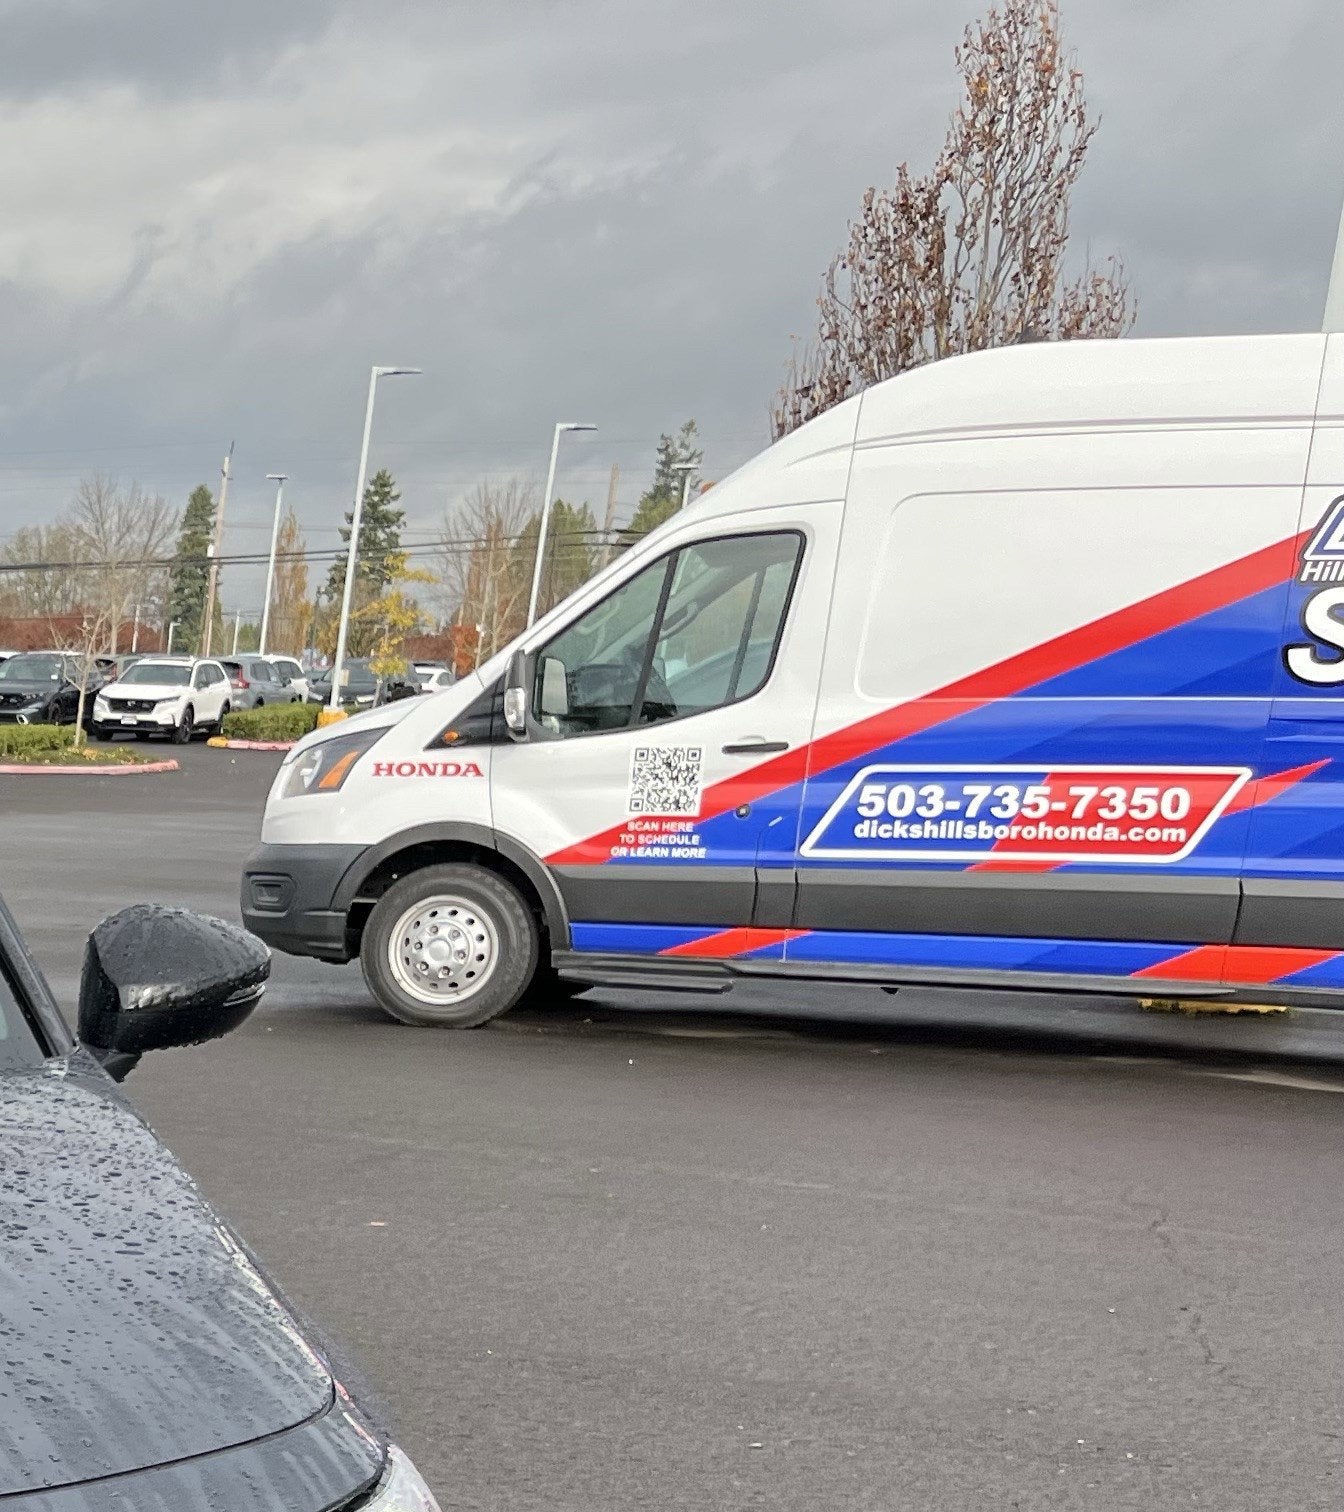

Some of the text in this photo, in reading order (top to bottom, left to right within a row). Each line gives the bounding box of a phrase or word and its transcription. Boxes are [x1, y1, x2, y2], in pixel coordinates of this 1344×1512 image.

[372, 761, 484, 778] HONDA
[856, 784, 1191, 821] 503-735-7350
[627, 820, 694, 832] SCAN HERE
[853, 820, 1187, 843] dickshillsborohonda.com
[619, 833, 700, 845] TO SCHEDULE
[610, 846, 707, 859] OR LEARN MORE
